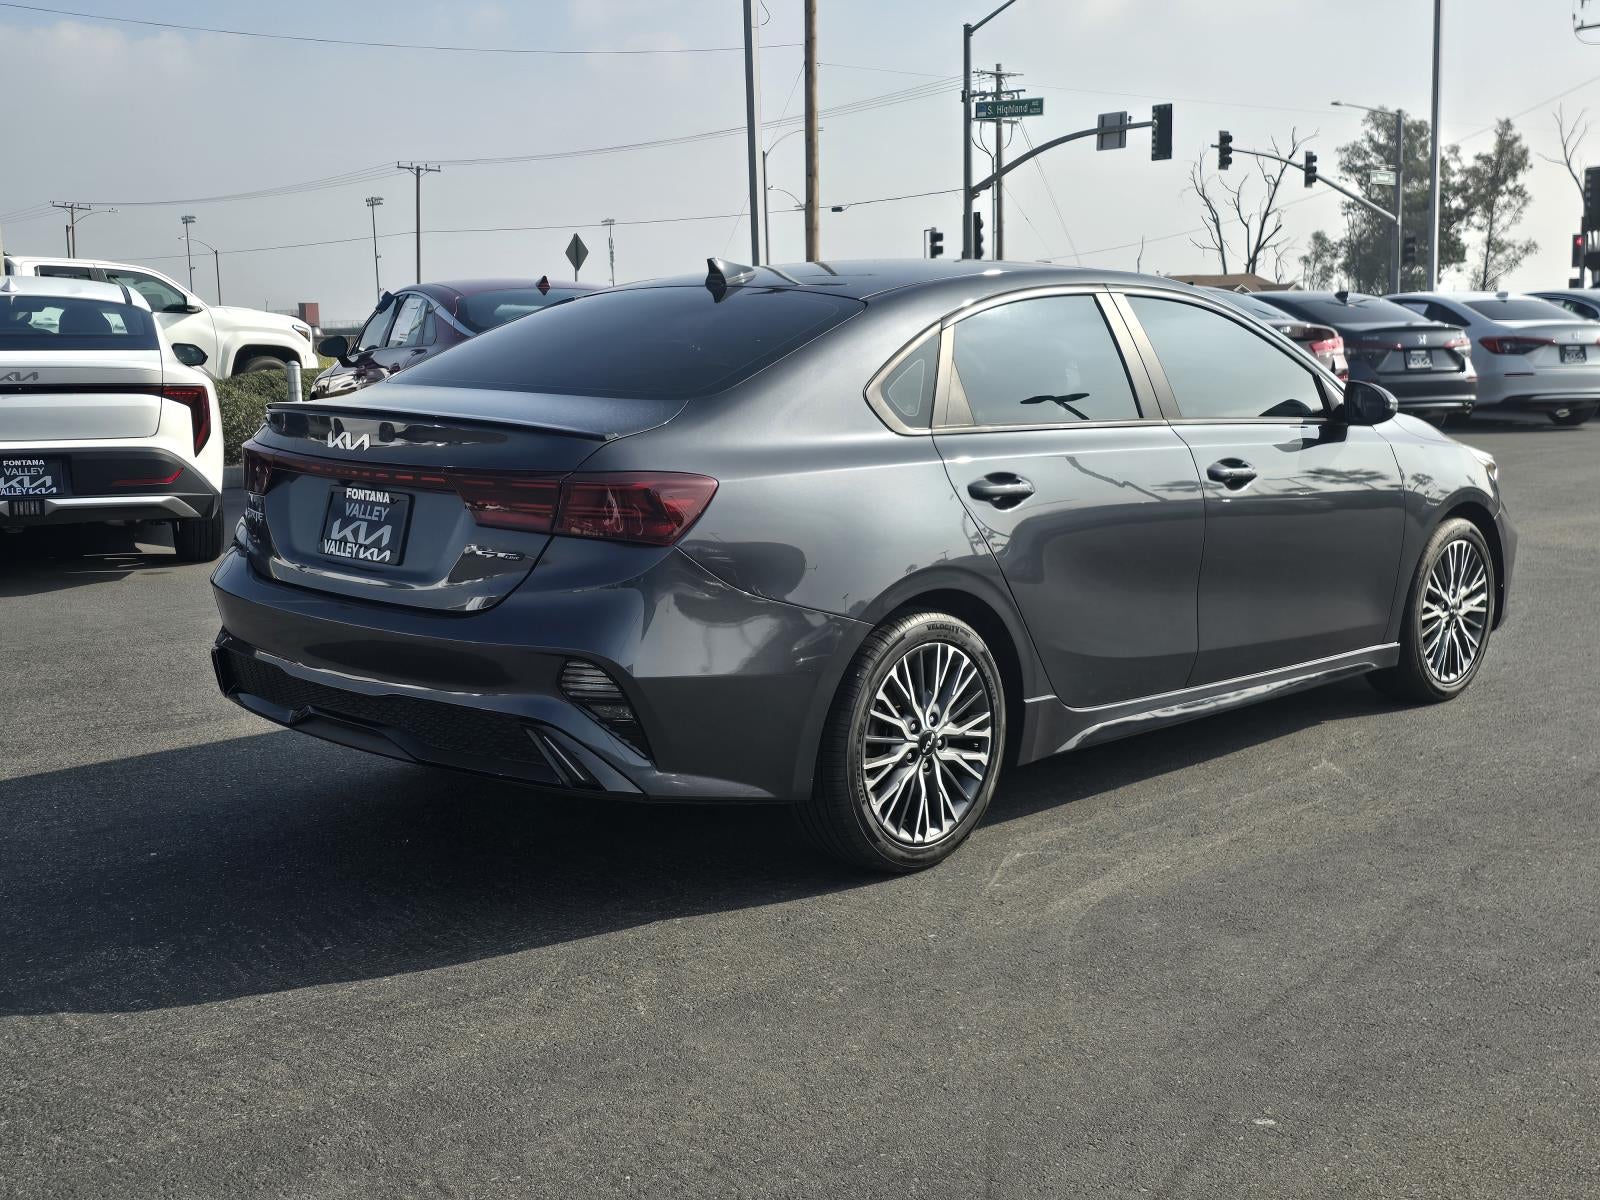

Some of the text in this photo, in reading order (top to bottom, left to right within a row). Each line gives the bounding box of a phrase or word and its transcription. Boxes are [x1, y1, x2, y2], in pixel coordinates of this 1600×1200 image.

[996, 104, 1028, 115] Highland
[327, 430, 370, 451] KIA
[4, 467, 44, 475] VALLEY
[0, 476, 52, 488] KIA
[346, 488, 390, 503] FONTANA
[345, 502, 389, 521] VALLEY
[331, 518, 392, 547] KIA
[324, 539, 391, 561] VALLEY KIA
[926, 623, 961, 635] VELOCITY
